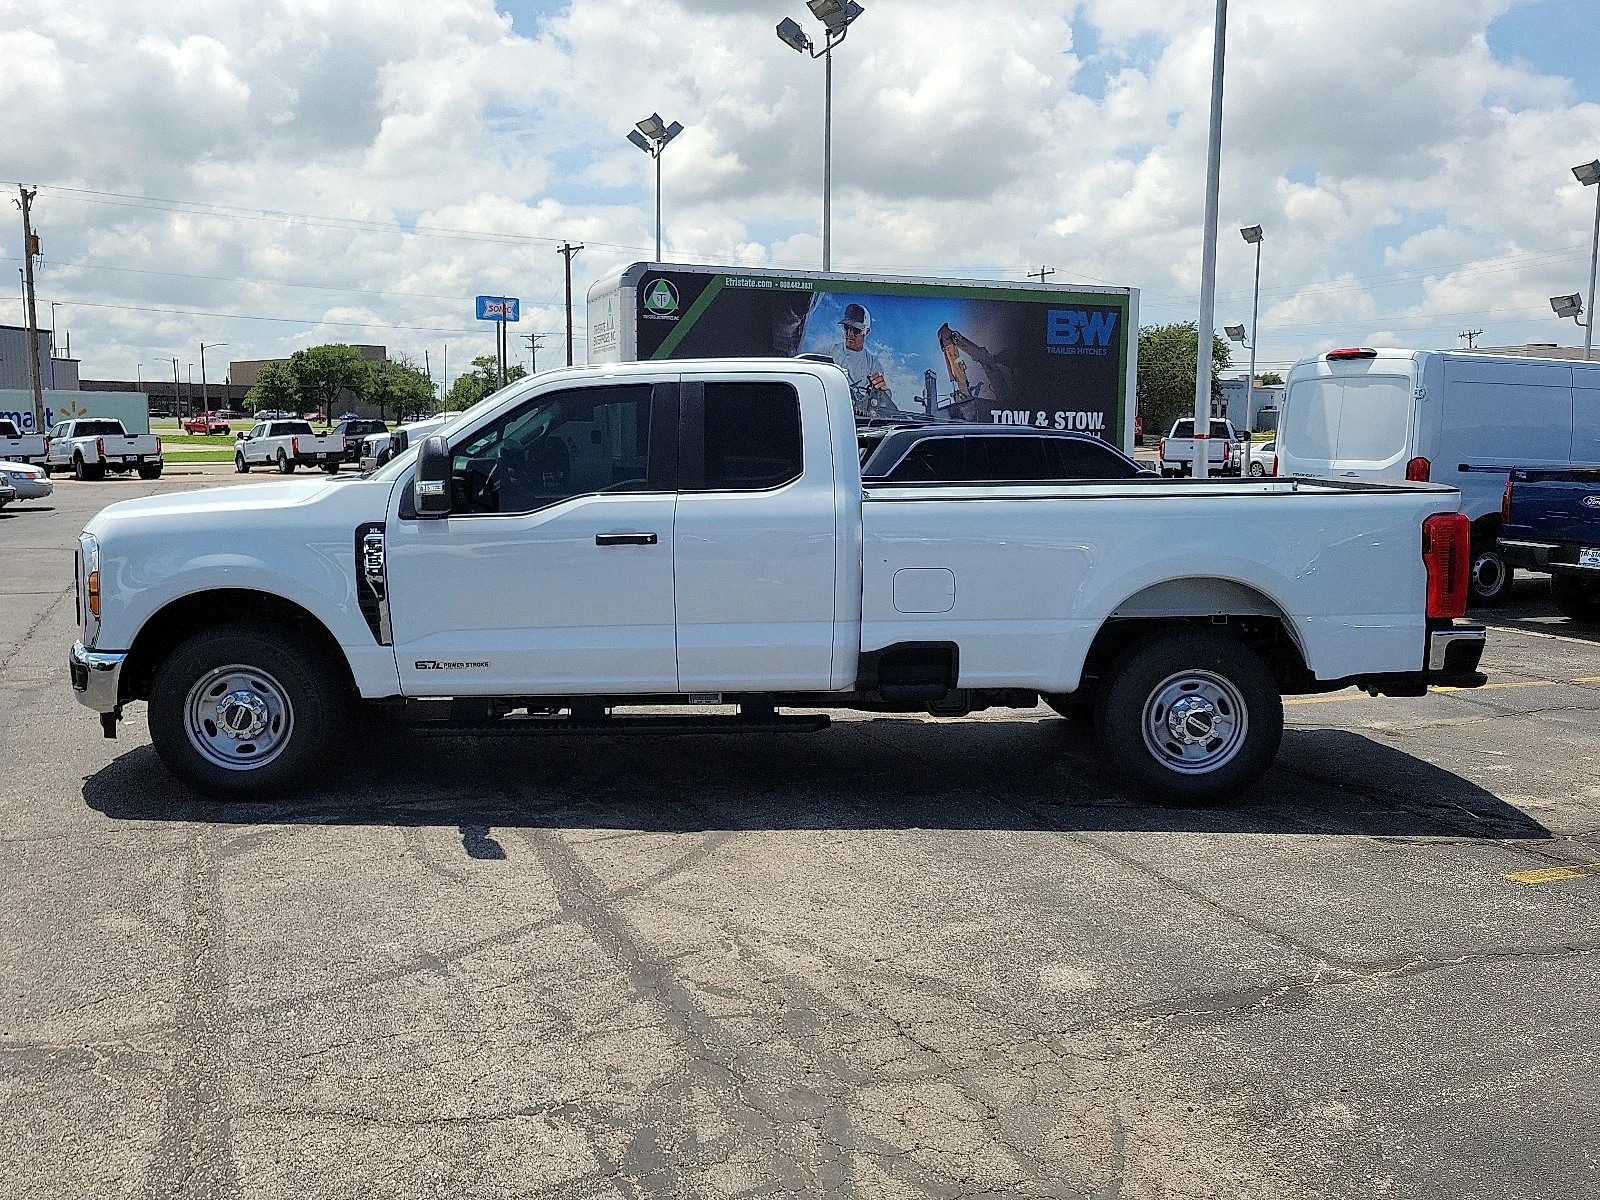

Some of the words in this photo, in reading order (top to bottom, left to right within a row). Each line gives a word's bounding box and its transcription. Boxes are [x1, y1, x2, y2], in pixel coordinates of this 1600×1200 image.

[725, 278, 772, 288] Etristate.com
[1046, 346, 1076, 355] TRAILER
[1077, 347, 1107, 356] HITCHES
[990, 410, 1030, 425] TOW
[1035, 411, 1049, 426] &
